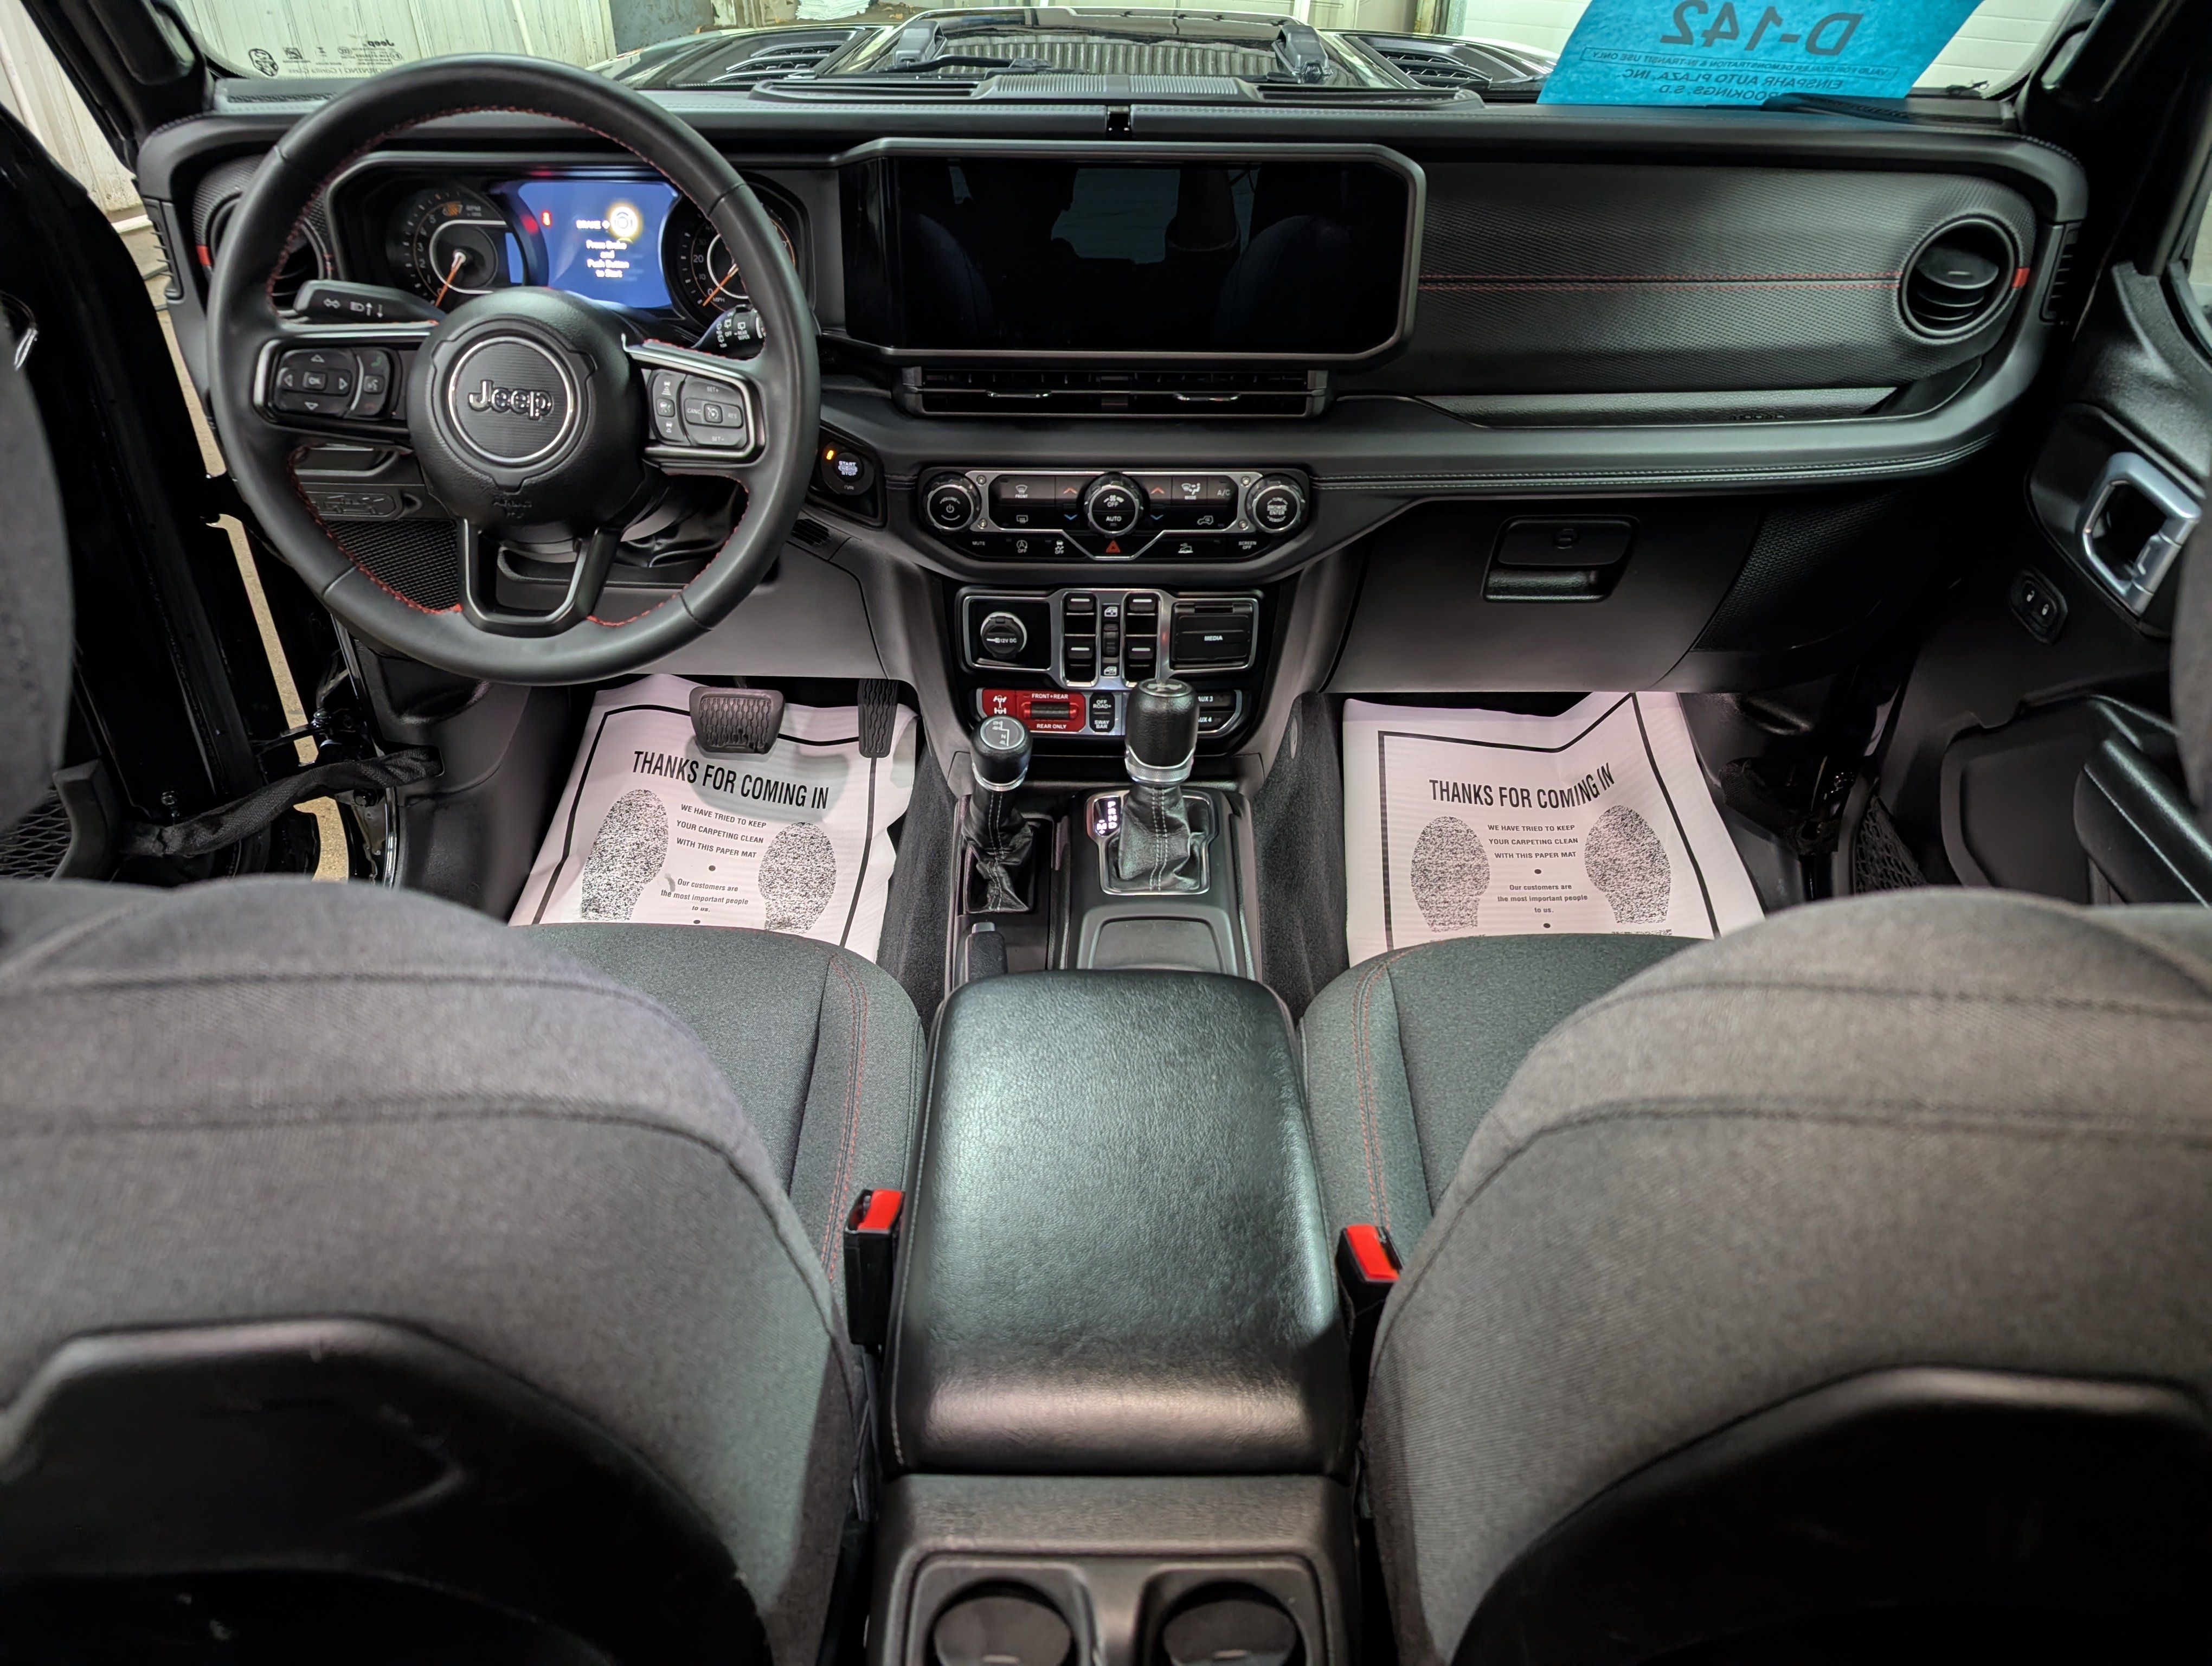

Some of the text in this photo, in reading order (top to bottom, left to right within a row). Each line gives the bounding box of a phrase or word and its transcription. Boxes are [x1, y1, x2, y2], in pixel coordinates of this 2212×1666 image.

[417, 242, 423, 252] 3
[419, 259, 426, 268] 2
[693, 254, 704, 263] 20
[468, 380, 554, 420] Jeep
[633, 751, 829, 809] THANKS FOR COMING IN
[1429, 762, 1615, 809] THANKS FOR COMING IN
[681, 804, 693, 812] WE
[693, 808, 712, 817] HAVE
[715, 812, 735, 823] TRIED
[748, 820, 767, 828] KEEP
[677, 820, 764, 843] YOUR CARPETING CLEAN
[677, 837, 696, 848] WITH
[698, 843, 714, 851] THIS
[716, 847, 739, 856] PAPER
[677, 878, 690, 886] Our
[691, 881, 725, 890] customers
[692, 894, 724, 902] important
